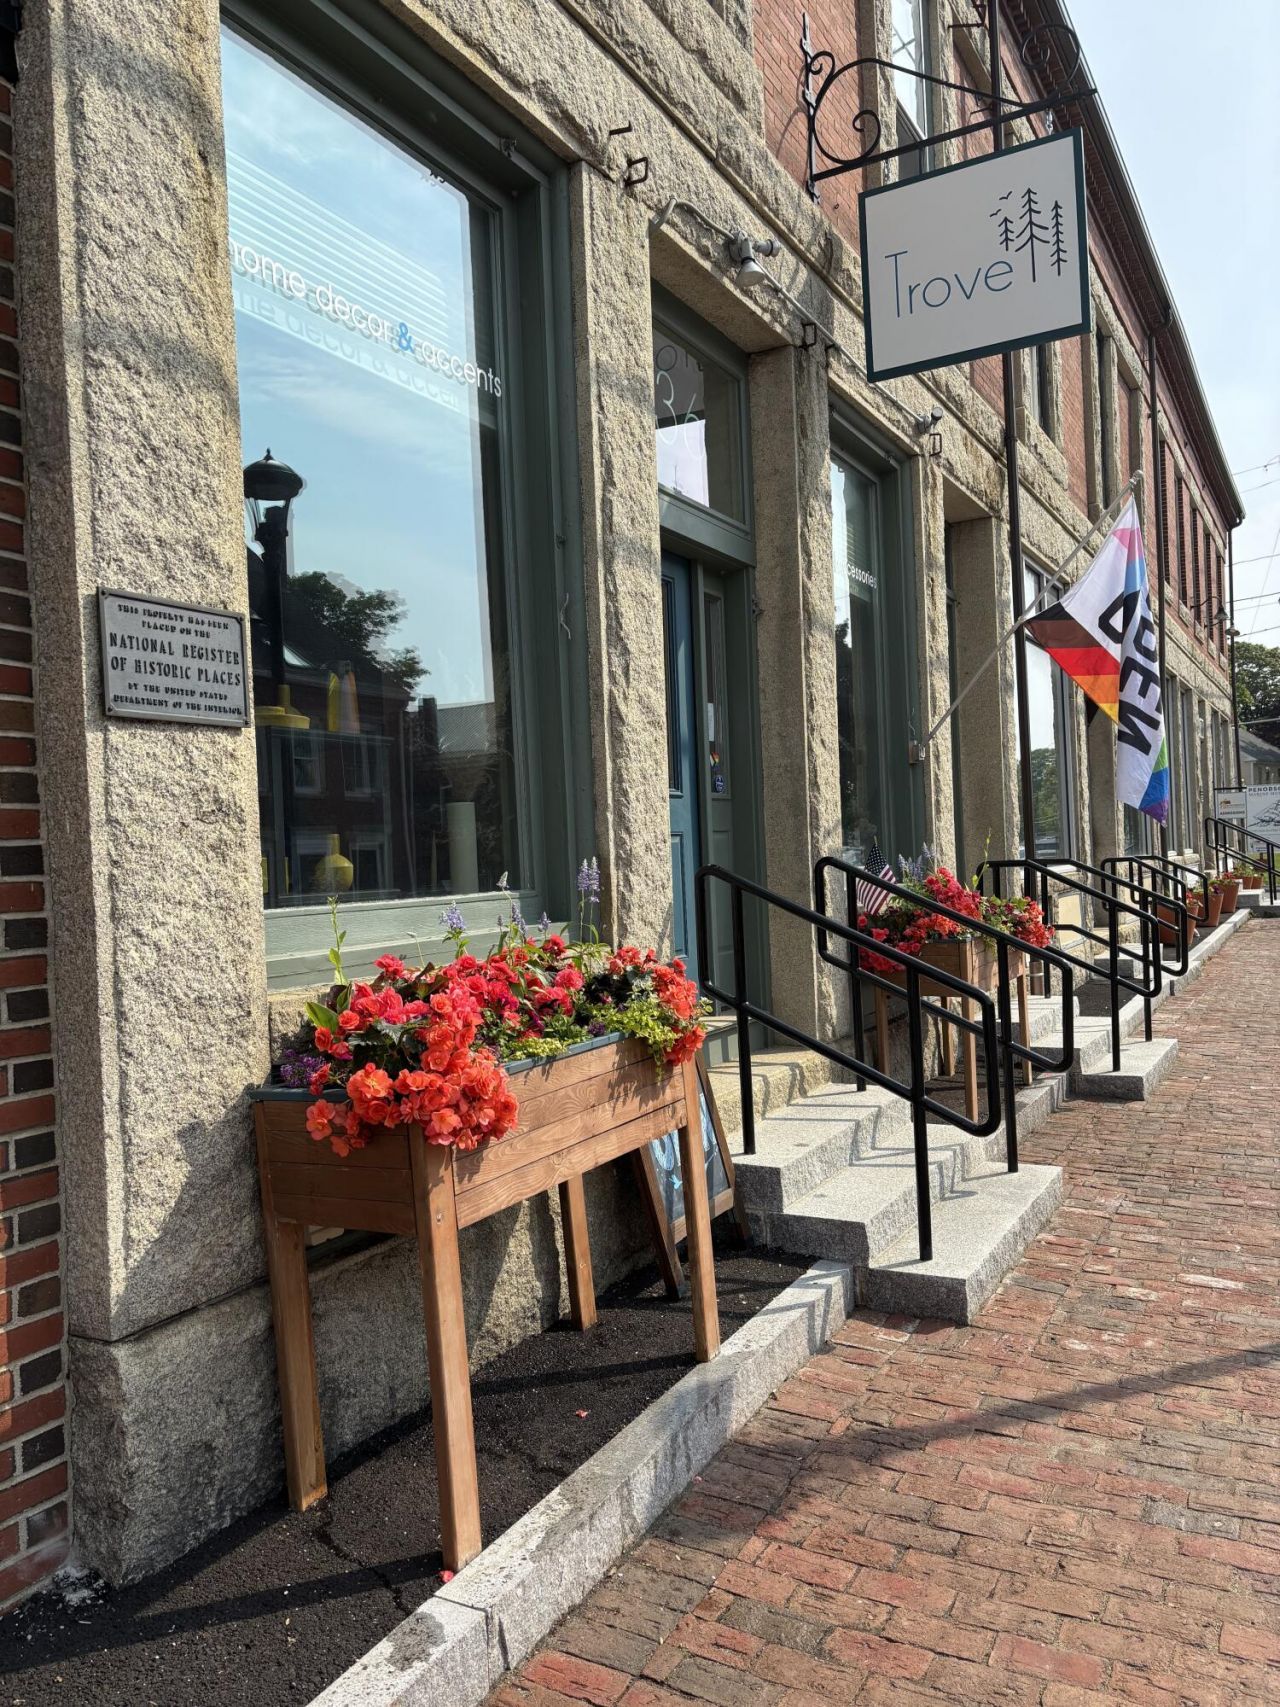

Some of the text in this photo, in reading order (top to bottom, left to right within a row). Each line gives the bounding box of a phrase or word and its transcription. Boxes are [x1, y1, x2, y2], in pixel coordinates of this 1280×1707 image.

[885, 250, 1014, 318] Trove
[316, 283, 392, 341] decor
[398, 322, 414, 353] &
[422, 341, 502, 397] accents
[846, 563, 878, 589] cessories
[117, 603, 229, 630] THIS PROPERTY HAS BEEN
[141, 620, 211, 639] PLACED ON THE
[109, 631, 240, 665] NATIONAL REGISTER
[110, 655, 241, 687] OF HISTORIC PLACES
[1098, 590, 1162, 756] OPEN
[113, 693, 242, 715] DEPARTMENT OF THE INTERIOR
[127, 682, 228, 701] BY THE UNITED STATES
